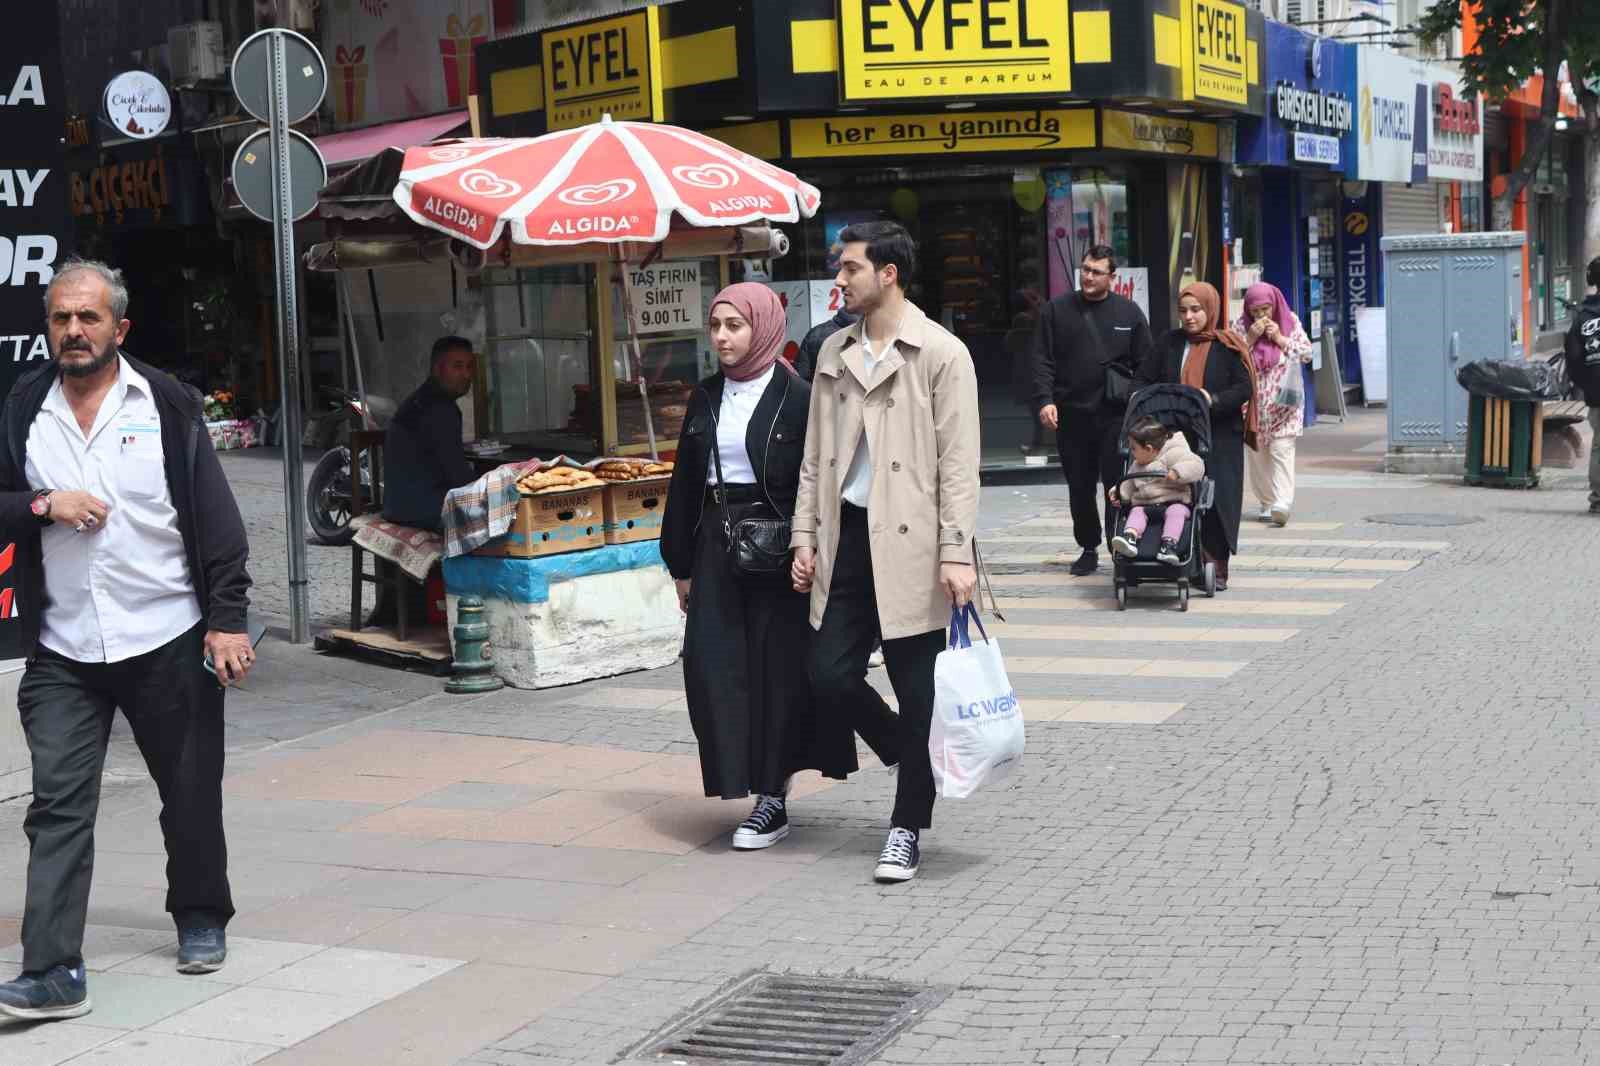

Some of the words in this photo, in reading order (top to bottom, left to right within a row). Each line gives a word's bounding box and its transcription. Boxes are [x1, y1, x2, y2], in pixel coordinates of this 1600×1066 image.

[862, 0, 1050, 52] EYFEL
[1198, 4, 1242, 64] EYFEL
[550, 27, 640, 91] EYFEL
[0, 65, 46, 106] A
[864, 78, 906, 88] EAU
[923, 76, 948, 86] DE
[964, 72, 1052, 85] PARFUM
[824, 122, 875, 145] her
[890, 122, 925, 138] an
[938, 110, 1060, 149] yanında
[629, 270, 655, 287] TAŞ
[659, 268, 697, 284] FIRIN
[645, 286, 683, 305] SİMİT
[641, 310, 670, 326] 9.00
[673, 308, 691, 322] TL
[542, 495, 590, 511] BANANAS
[627, 487, 668, 501] BANANA
[957, 702, 981, 720] LC
